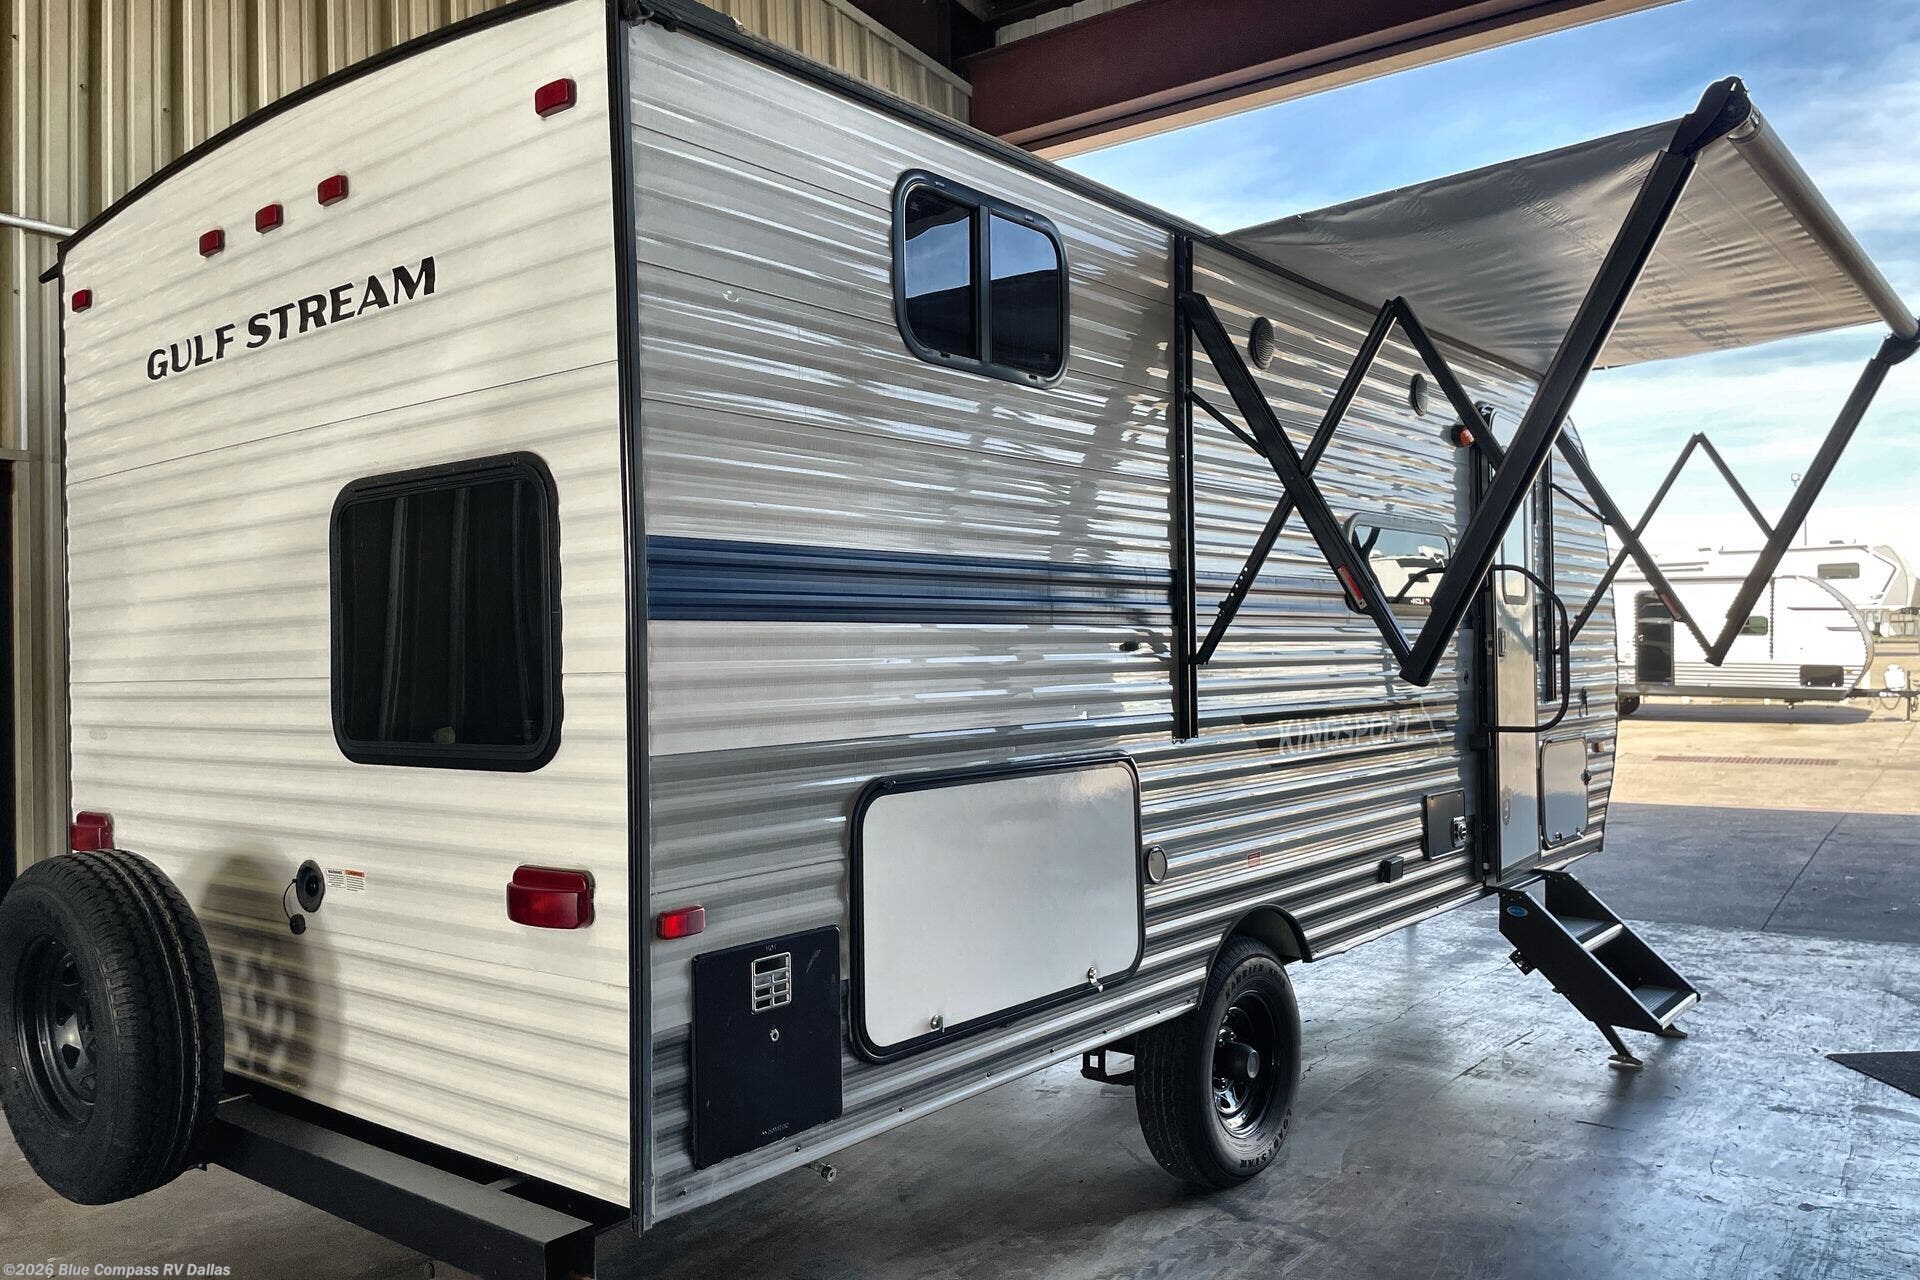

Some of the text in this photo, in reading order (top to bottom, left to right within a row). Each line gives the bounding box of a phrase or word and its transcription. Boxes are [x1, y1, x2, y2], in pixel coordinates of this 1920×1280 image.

[147, 256, 436, 380] GULF STREAM
[1277, 712, 1409, 755] KINGSPORT
